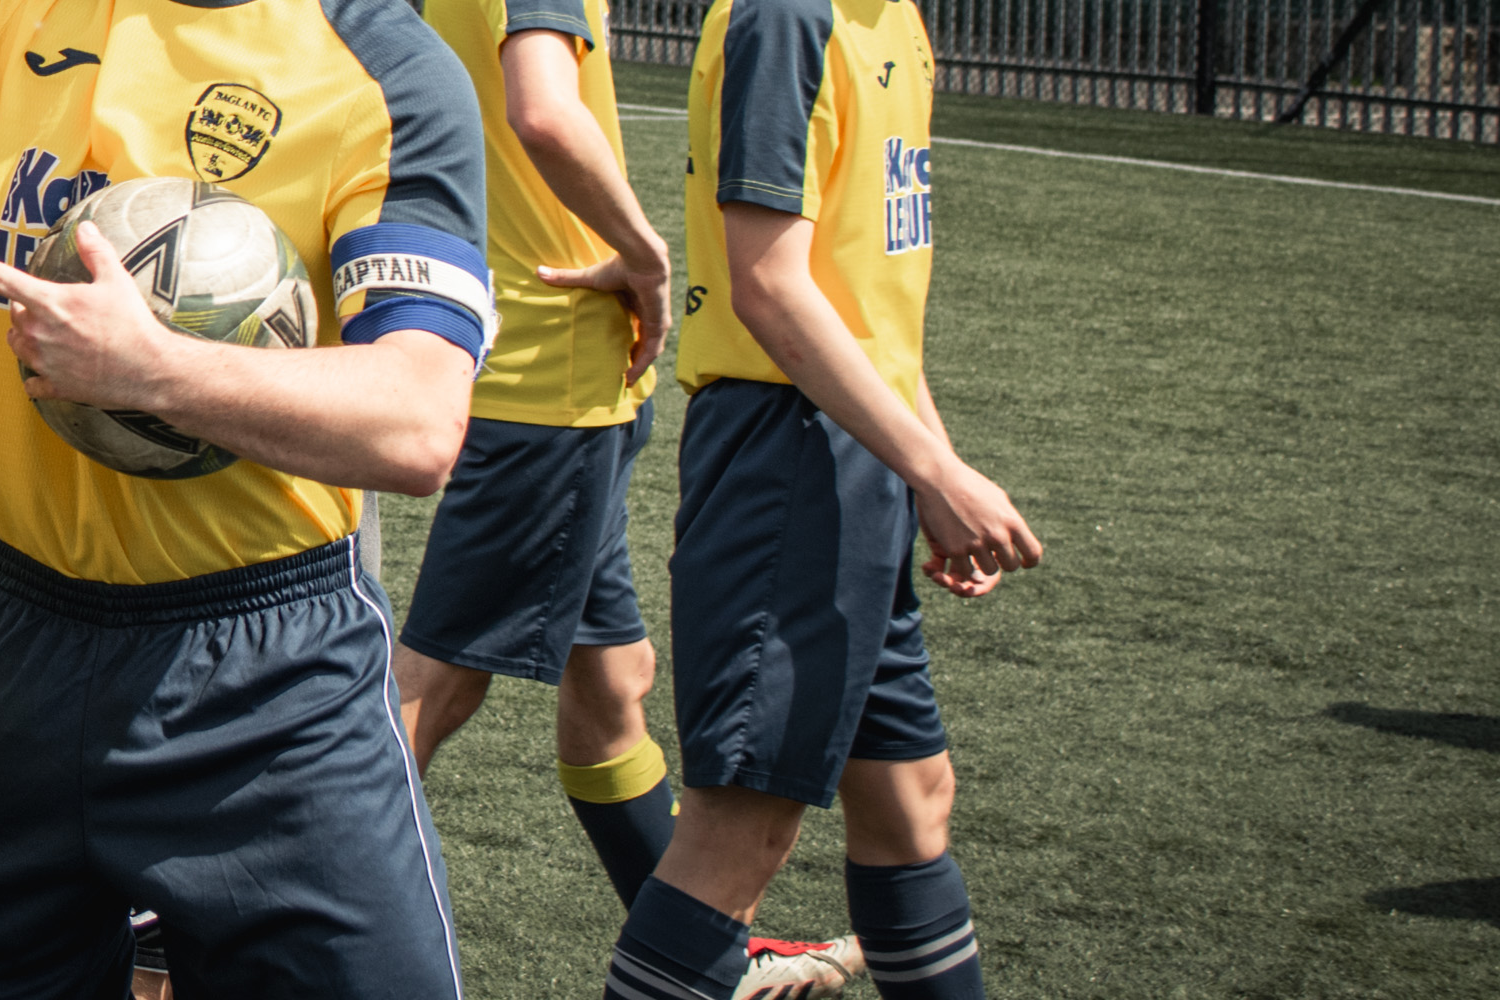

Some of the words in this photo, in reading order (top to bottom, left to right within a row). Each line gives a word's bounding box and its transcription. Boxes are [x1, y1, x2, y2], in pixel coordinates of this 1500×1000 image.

[214, 91, 257, 113] BAGLAN
[256, 104, 272, 122] FC
[334, 257, 431, 298] CAPTAIN
